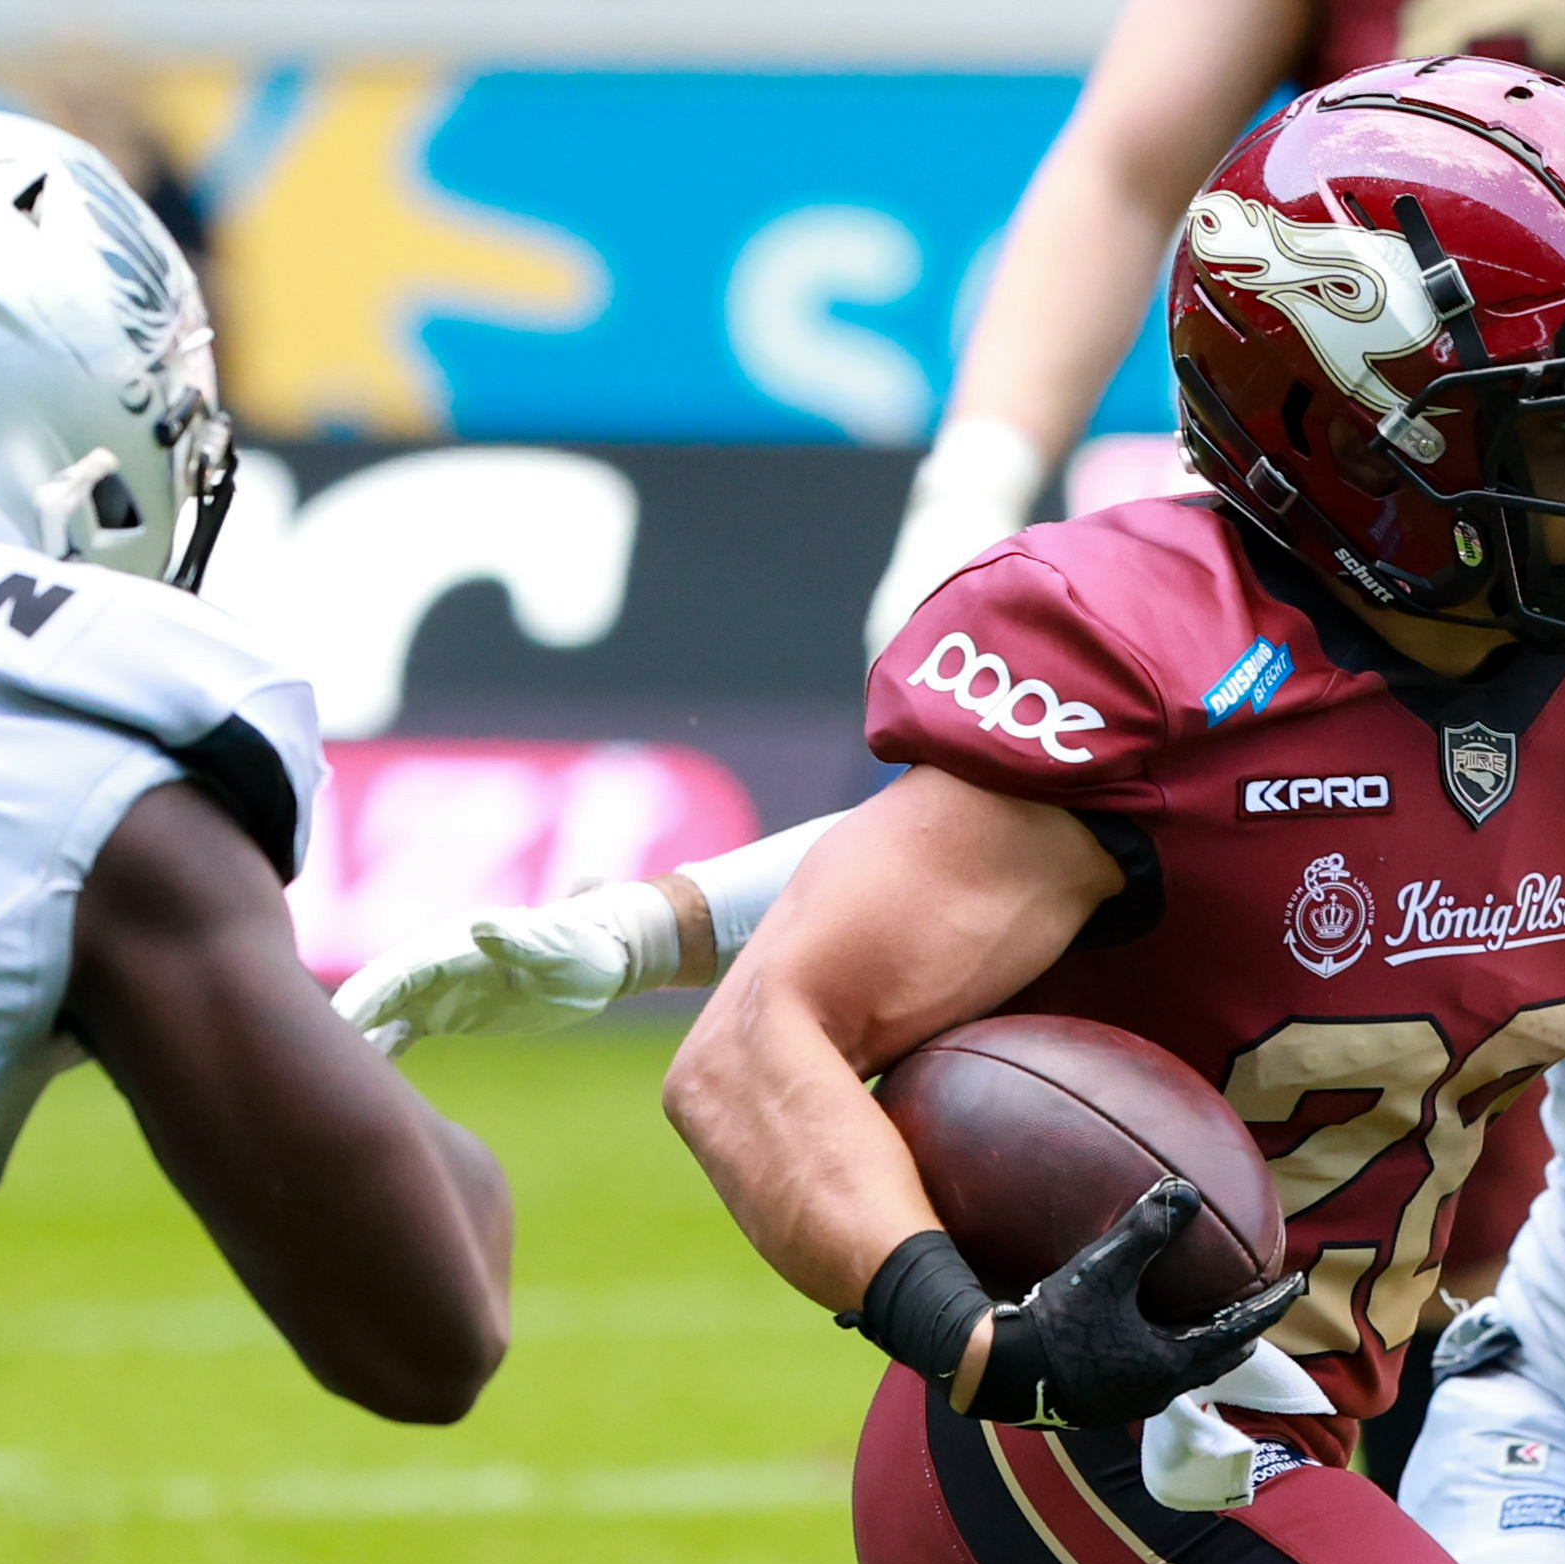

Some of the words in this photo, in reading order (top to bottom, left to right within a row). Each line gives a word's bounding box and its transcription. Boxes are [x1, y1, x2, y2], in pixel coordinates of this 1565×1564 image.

[1209, 643, 1273, 717] DUISBURG
[1265, 652, 1287, 686] ECHT
[1451, 748, 1507, 779] FIRE
